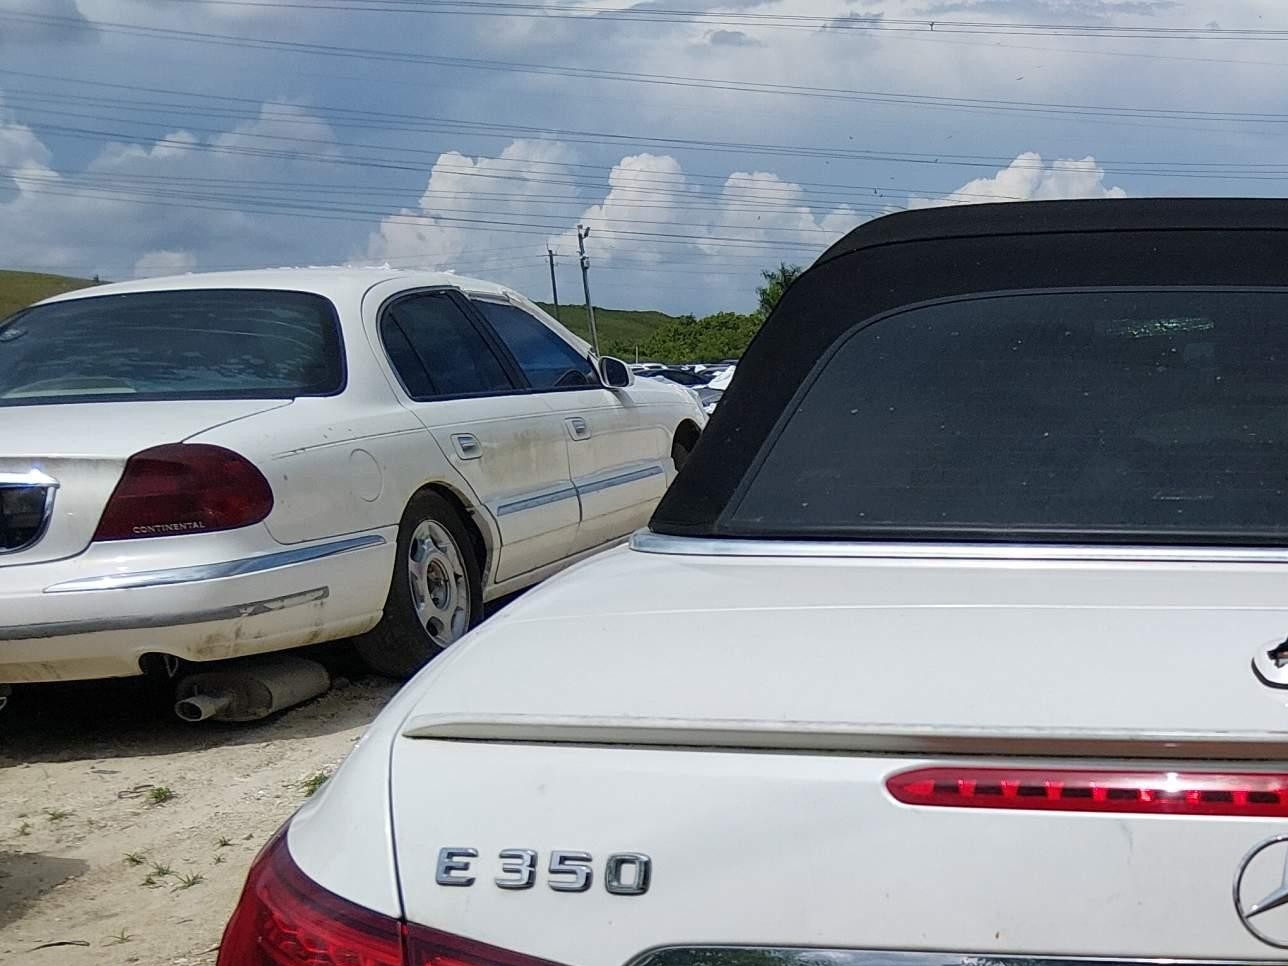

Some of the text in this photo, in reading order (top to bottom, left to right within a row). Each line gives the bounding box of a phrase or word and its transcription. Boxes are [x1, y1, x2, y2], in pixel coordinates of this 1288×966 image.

[132, 521, 206, 533] CONTINENTAL
[435, 847, 653, 896] E 350
